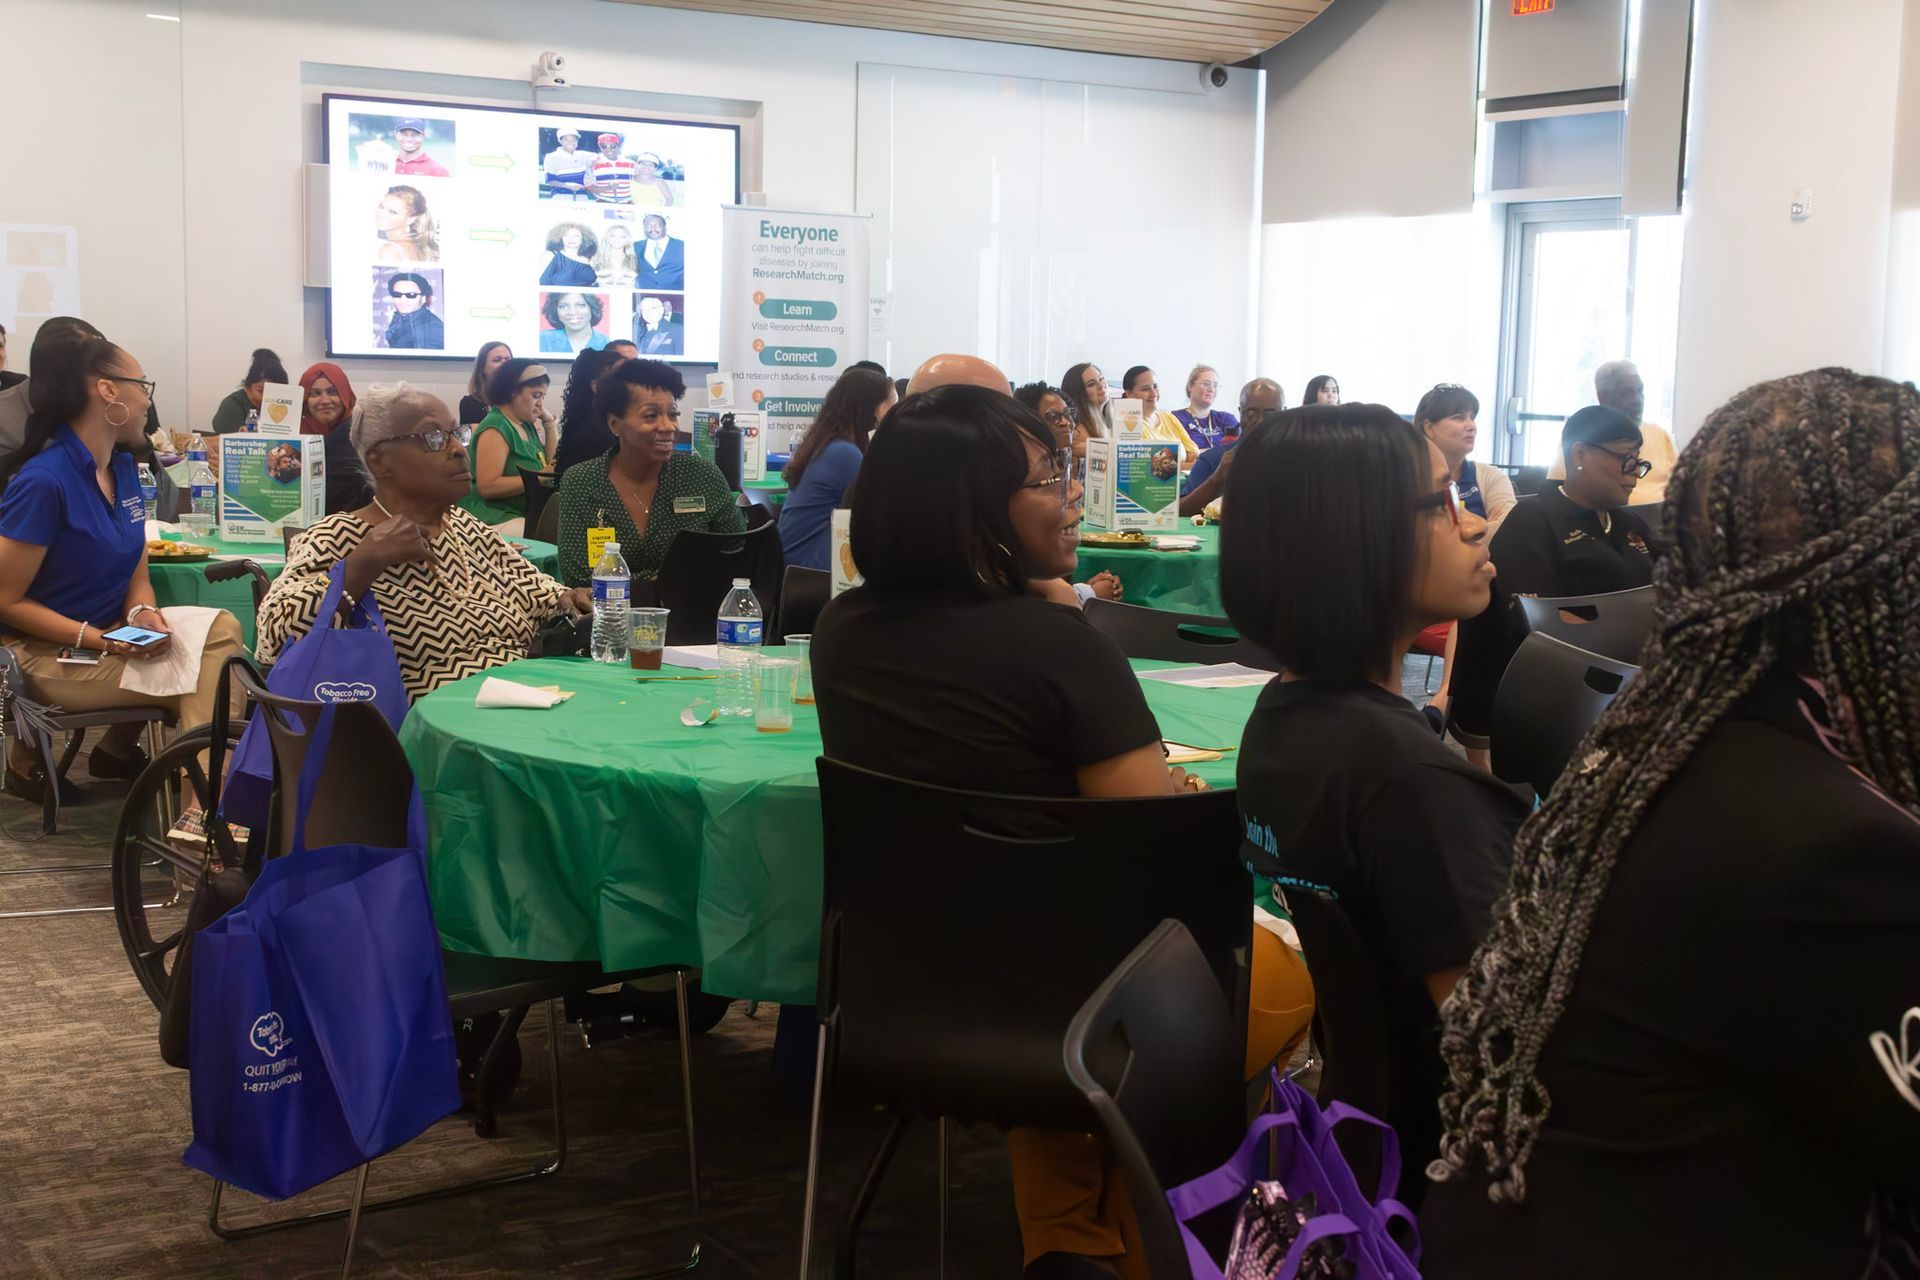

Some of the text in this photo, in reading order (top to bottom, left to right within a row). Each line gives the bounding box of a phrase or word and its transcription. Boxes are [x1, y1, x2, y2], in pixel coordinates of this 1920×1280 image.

[760, 220, 839, 244] Everyone
[752, 243, 846, 257] can help fight difficult
[760, 256, 839, 271] diseases by joining
[752, 267, 845, 284] ResearchMatch.org
[783, 302, 813, 316] Learn
[751, 321, 845, 336] Visit ResearchMatch.org
[774, 349, 818, 363] Connect
[746, 372, 780, 381] research
[781, 373, 809, 381] studies
[818, 374, 840, 382] resea
[765, 400, 823, 413] Get Involve
[777, 422, 795, 432] help
[224, 440, 268, 448] Barbershop
[1118, 445, 1152, 453] Barbershop
[224, 447, 267, 456] Real Talk
[320, 687, 370, 697] Tobacco Free
[244, 1064, 271, 1078] QUIT
